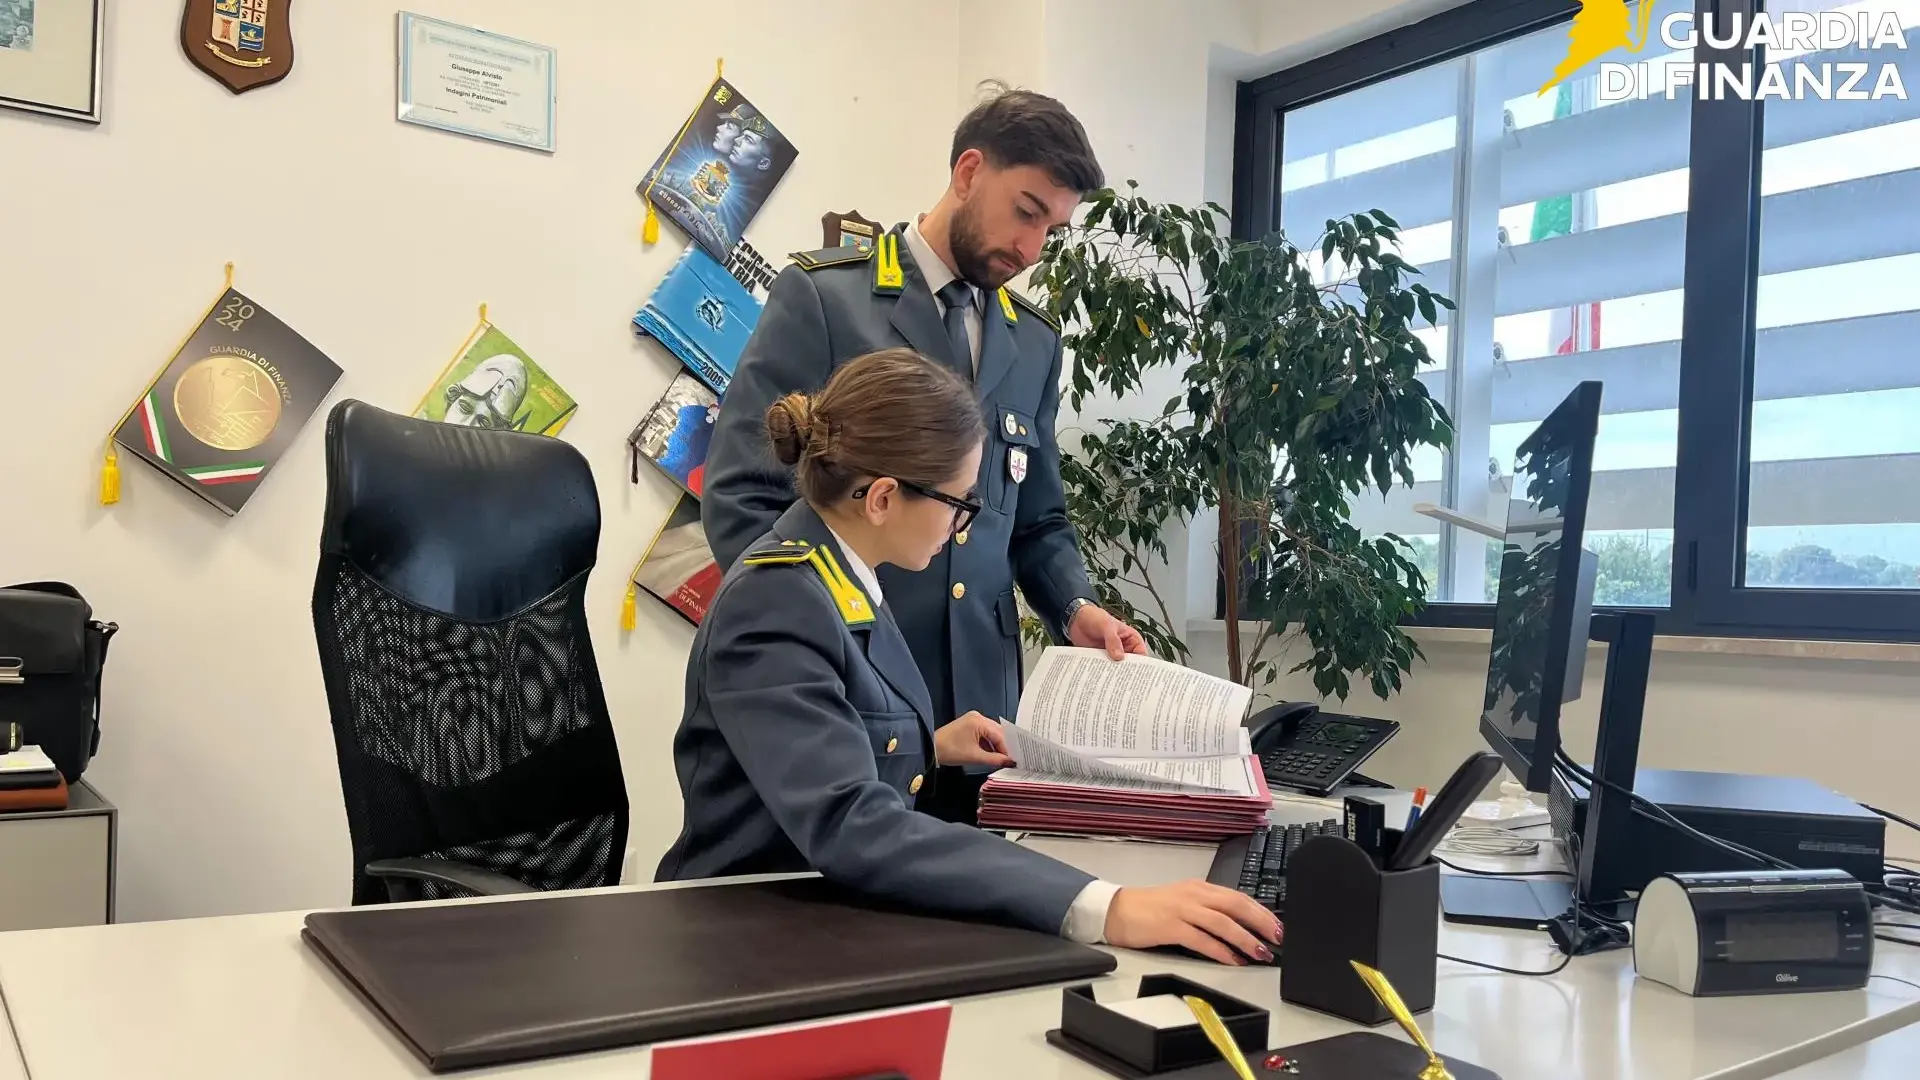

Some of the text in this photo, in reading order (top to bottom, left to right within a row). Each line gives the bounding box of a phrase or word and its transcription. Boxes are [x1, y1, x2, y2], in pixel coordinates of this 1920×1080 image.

[451, 63, 481, 77] Giuseppe
[445, 86, 508, 106] Indagini Patrimoniali
[226, 296, 255, 320] 20
[216, 309, 245, 332] 24
[209, 345, 258, 362] GUARDIA
[257, 357, 270, 369] DI
[700, 361, 725, 387] 2009
[685, 595, 708, 615] FINANZ
